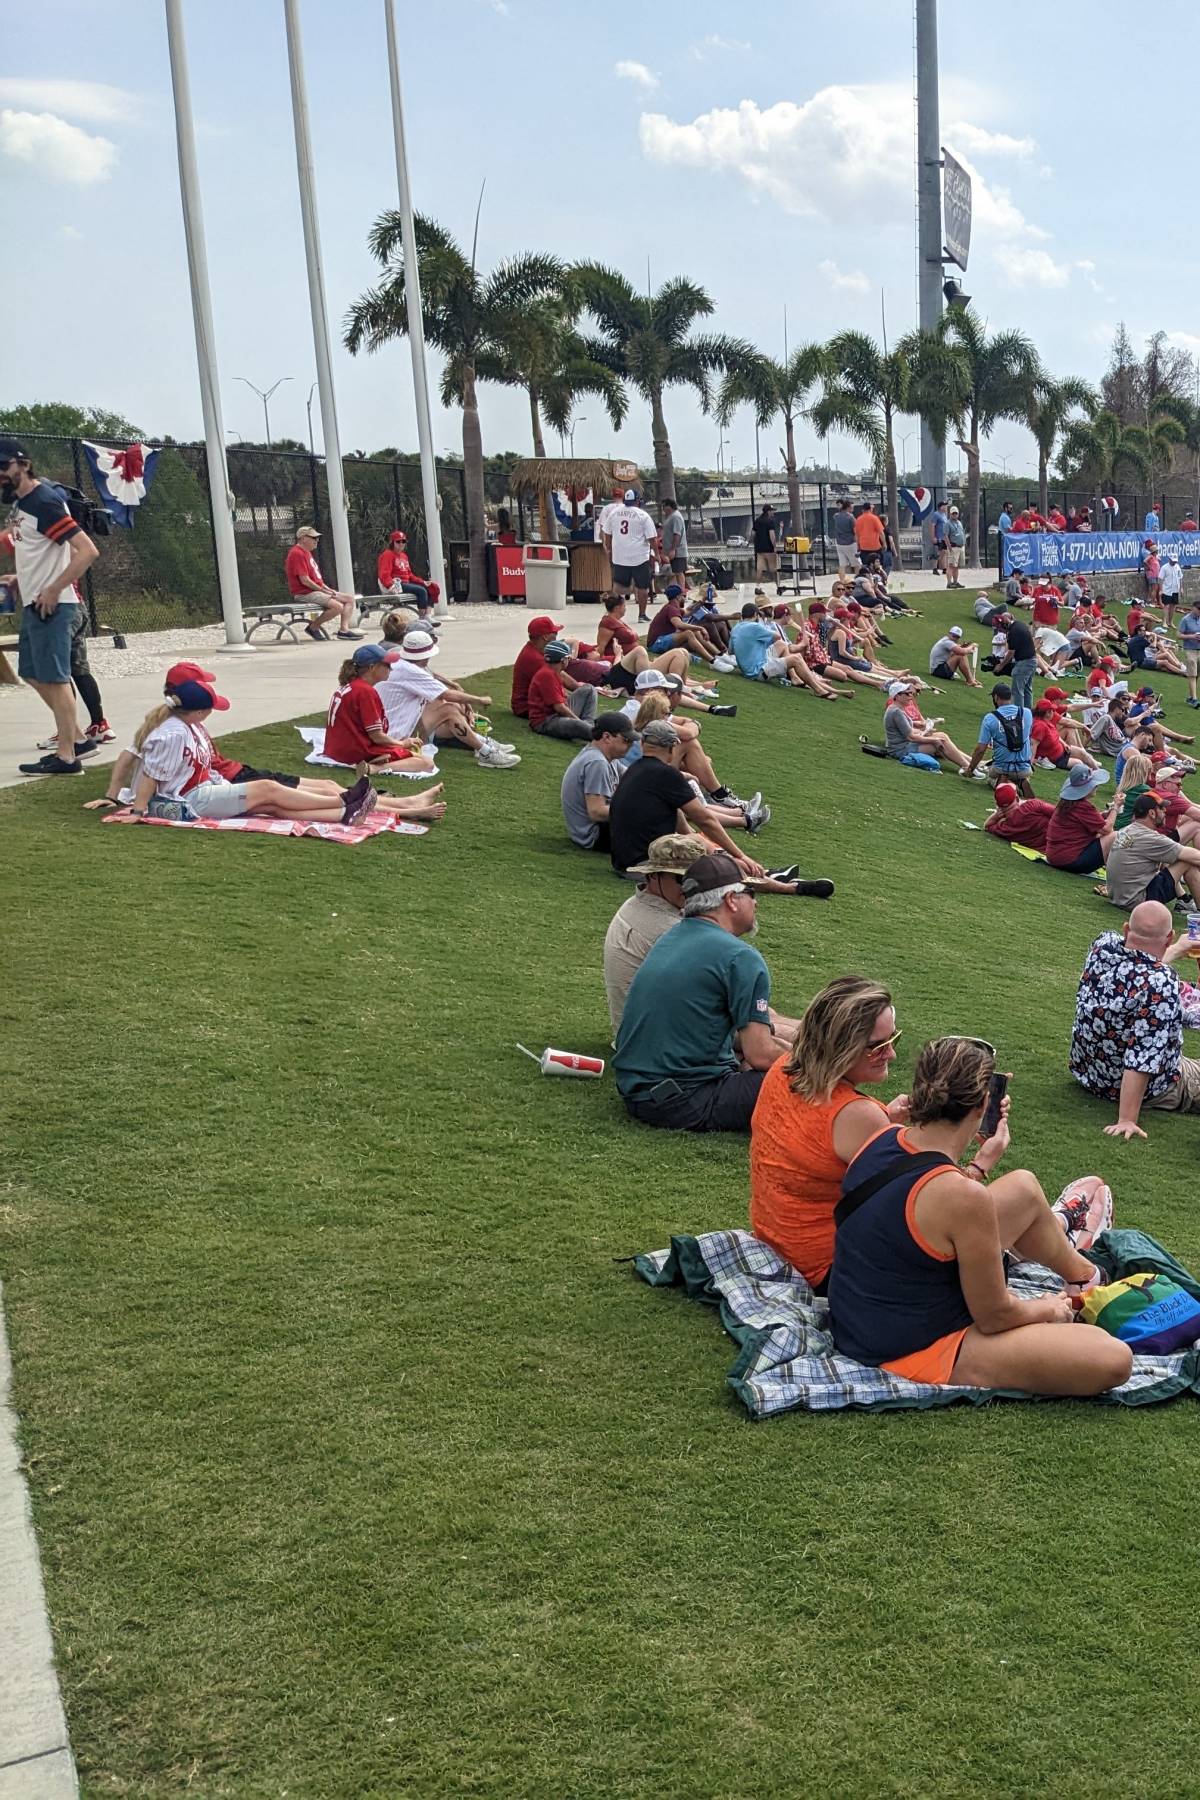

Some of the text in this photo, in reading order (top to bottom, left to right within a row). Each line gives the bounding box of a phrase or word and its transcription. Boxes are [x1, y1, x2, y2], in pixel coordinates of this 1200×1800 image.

[620, 520, 629, 535] 3
[1061, 540, 1140, 561] 1-877-U-CAN-NOW
[1137, 1310, 1160, 1322] The
[1158, 1296, 1183, 1314] Black
